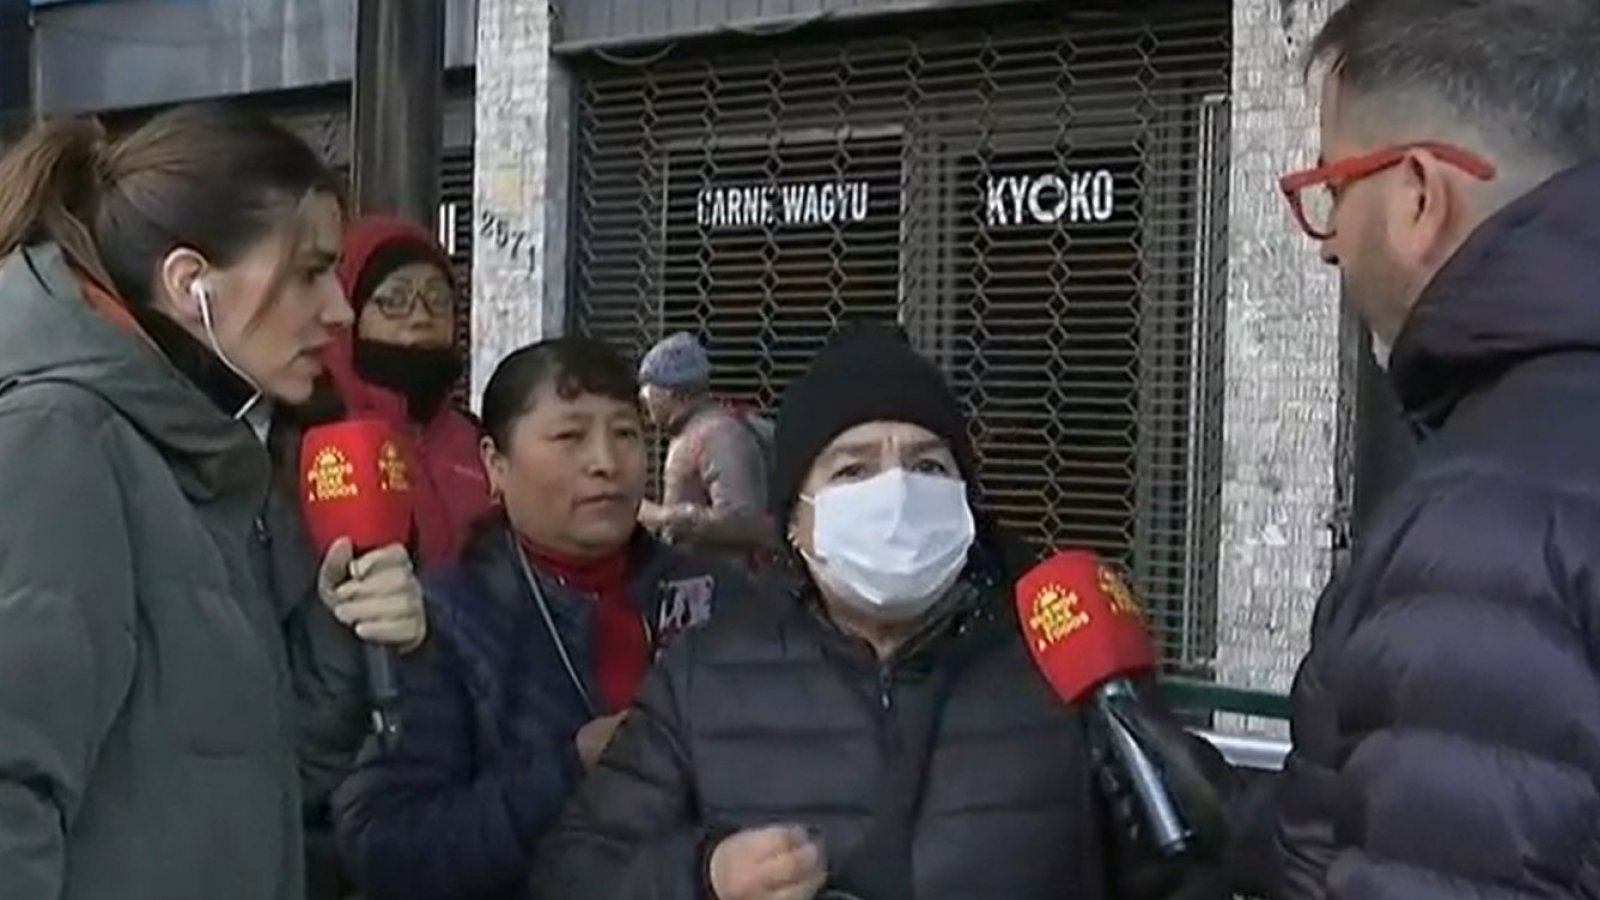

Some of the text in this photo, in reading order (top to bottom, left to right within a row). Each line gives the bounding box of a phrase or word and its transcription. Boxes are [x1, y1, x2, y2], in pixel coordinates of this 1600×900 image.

[698, 182, 868, 226] CARNE WAGYU
[986, 169, 1113, 226] KYOKO
